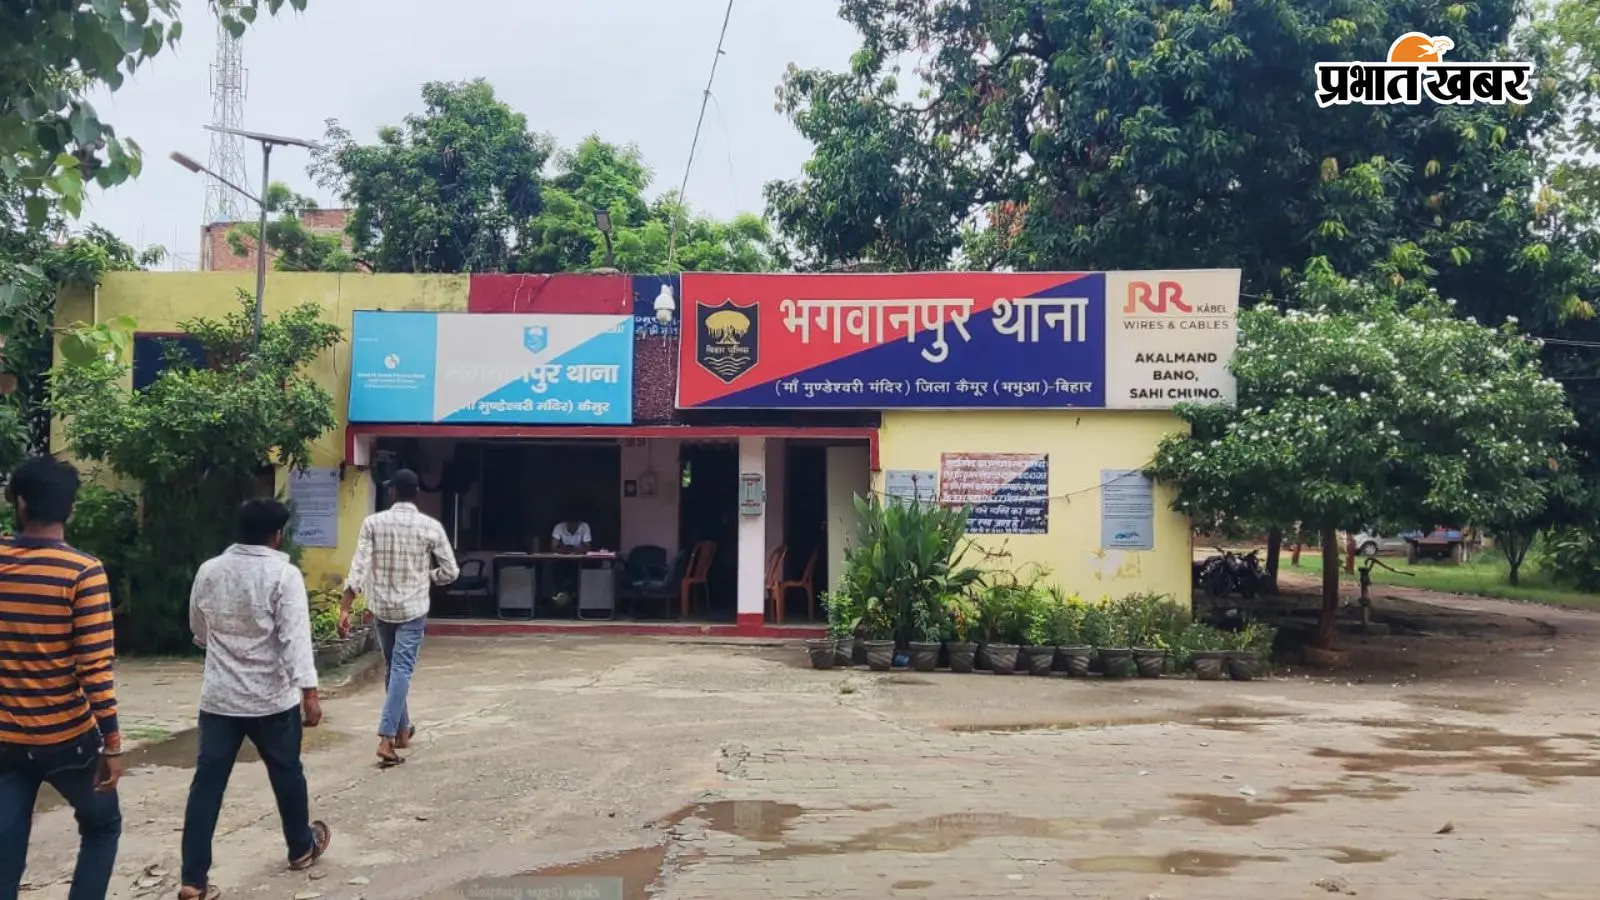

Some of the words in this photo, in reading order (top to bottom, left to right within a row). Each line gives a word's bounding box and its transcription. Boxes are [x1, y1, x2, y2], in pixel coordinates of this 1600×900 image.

[1123, 281, 1192, 313] RR
[779, 297, 974, 363] भगवानपुर
[991, 297, 1089, 343] थाना
[1123, 320, 1164, 330] WIRES
[1168, 320, 1176, 330] &
[1180, 320, 1229, 330] CABLES
[1135, 353, 1217, 363] AKALMAND
[566, 363, 620, 384] थाना
[1153, 370, 1199, 382] BANO,
[803, 378, 864, 398] मुण्डेश्वरी
[869, 378, 911, 397] मंदिर)
[915, 378, 950, 394] जिला
[955, 377, 988, 397] कैमूर
[1130, 388, 1162, 399] SAHI
